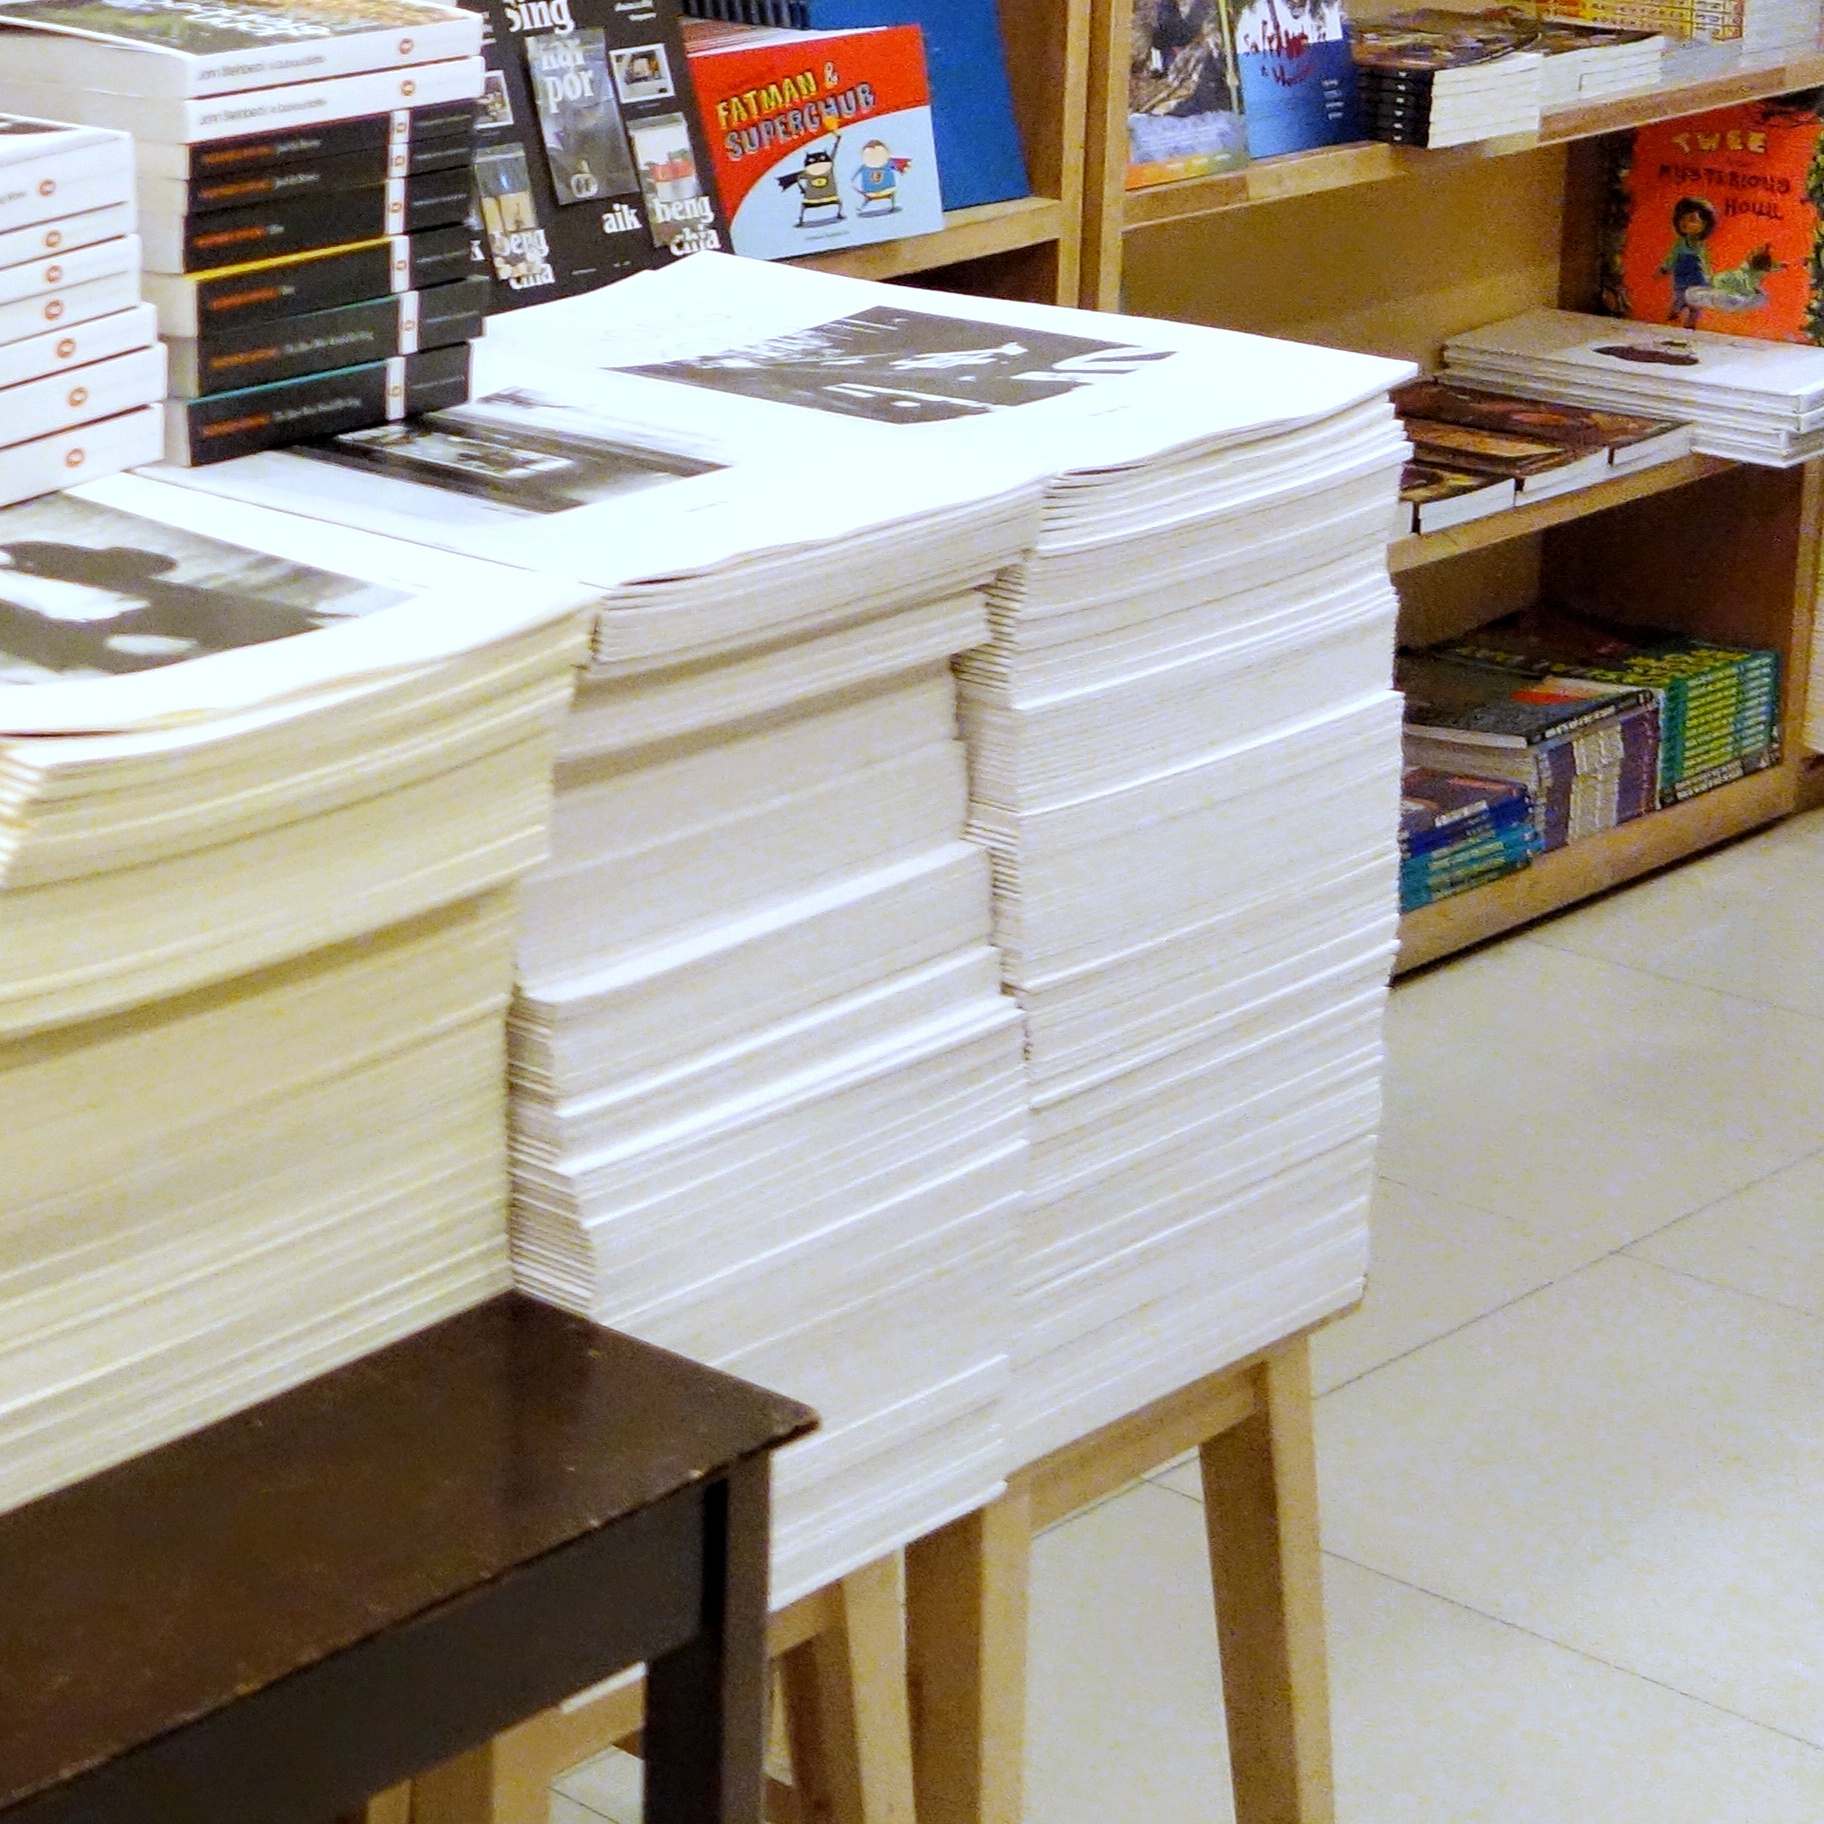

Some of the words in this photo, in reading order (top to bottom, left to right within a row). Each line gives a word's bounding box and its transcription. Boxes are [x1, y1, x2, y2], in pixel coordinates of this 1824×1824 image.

[543, 65, 595, 113] por
[714, 70, 817, 133] FATMAN
[822, 60, 841, 90] &
[723, 81, 878, 164] SUPERCHUB
[1671, 129, 1768, 155] TWEE
[601, 202, 643, 237] aik
[650, 194, 715, 226] beng
